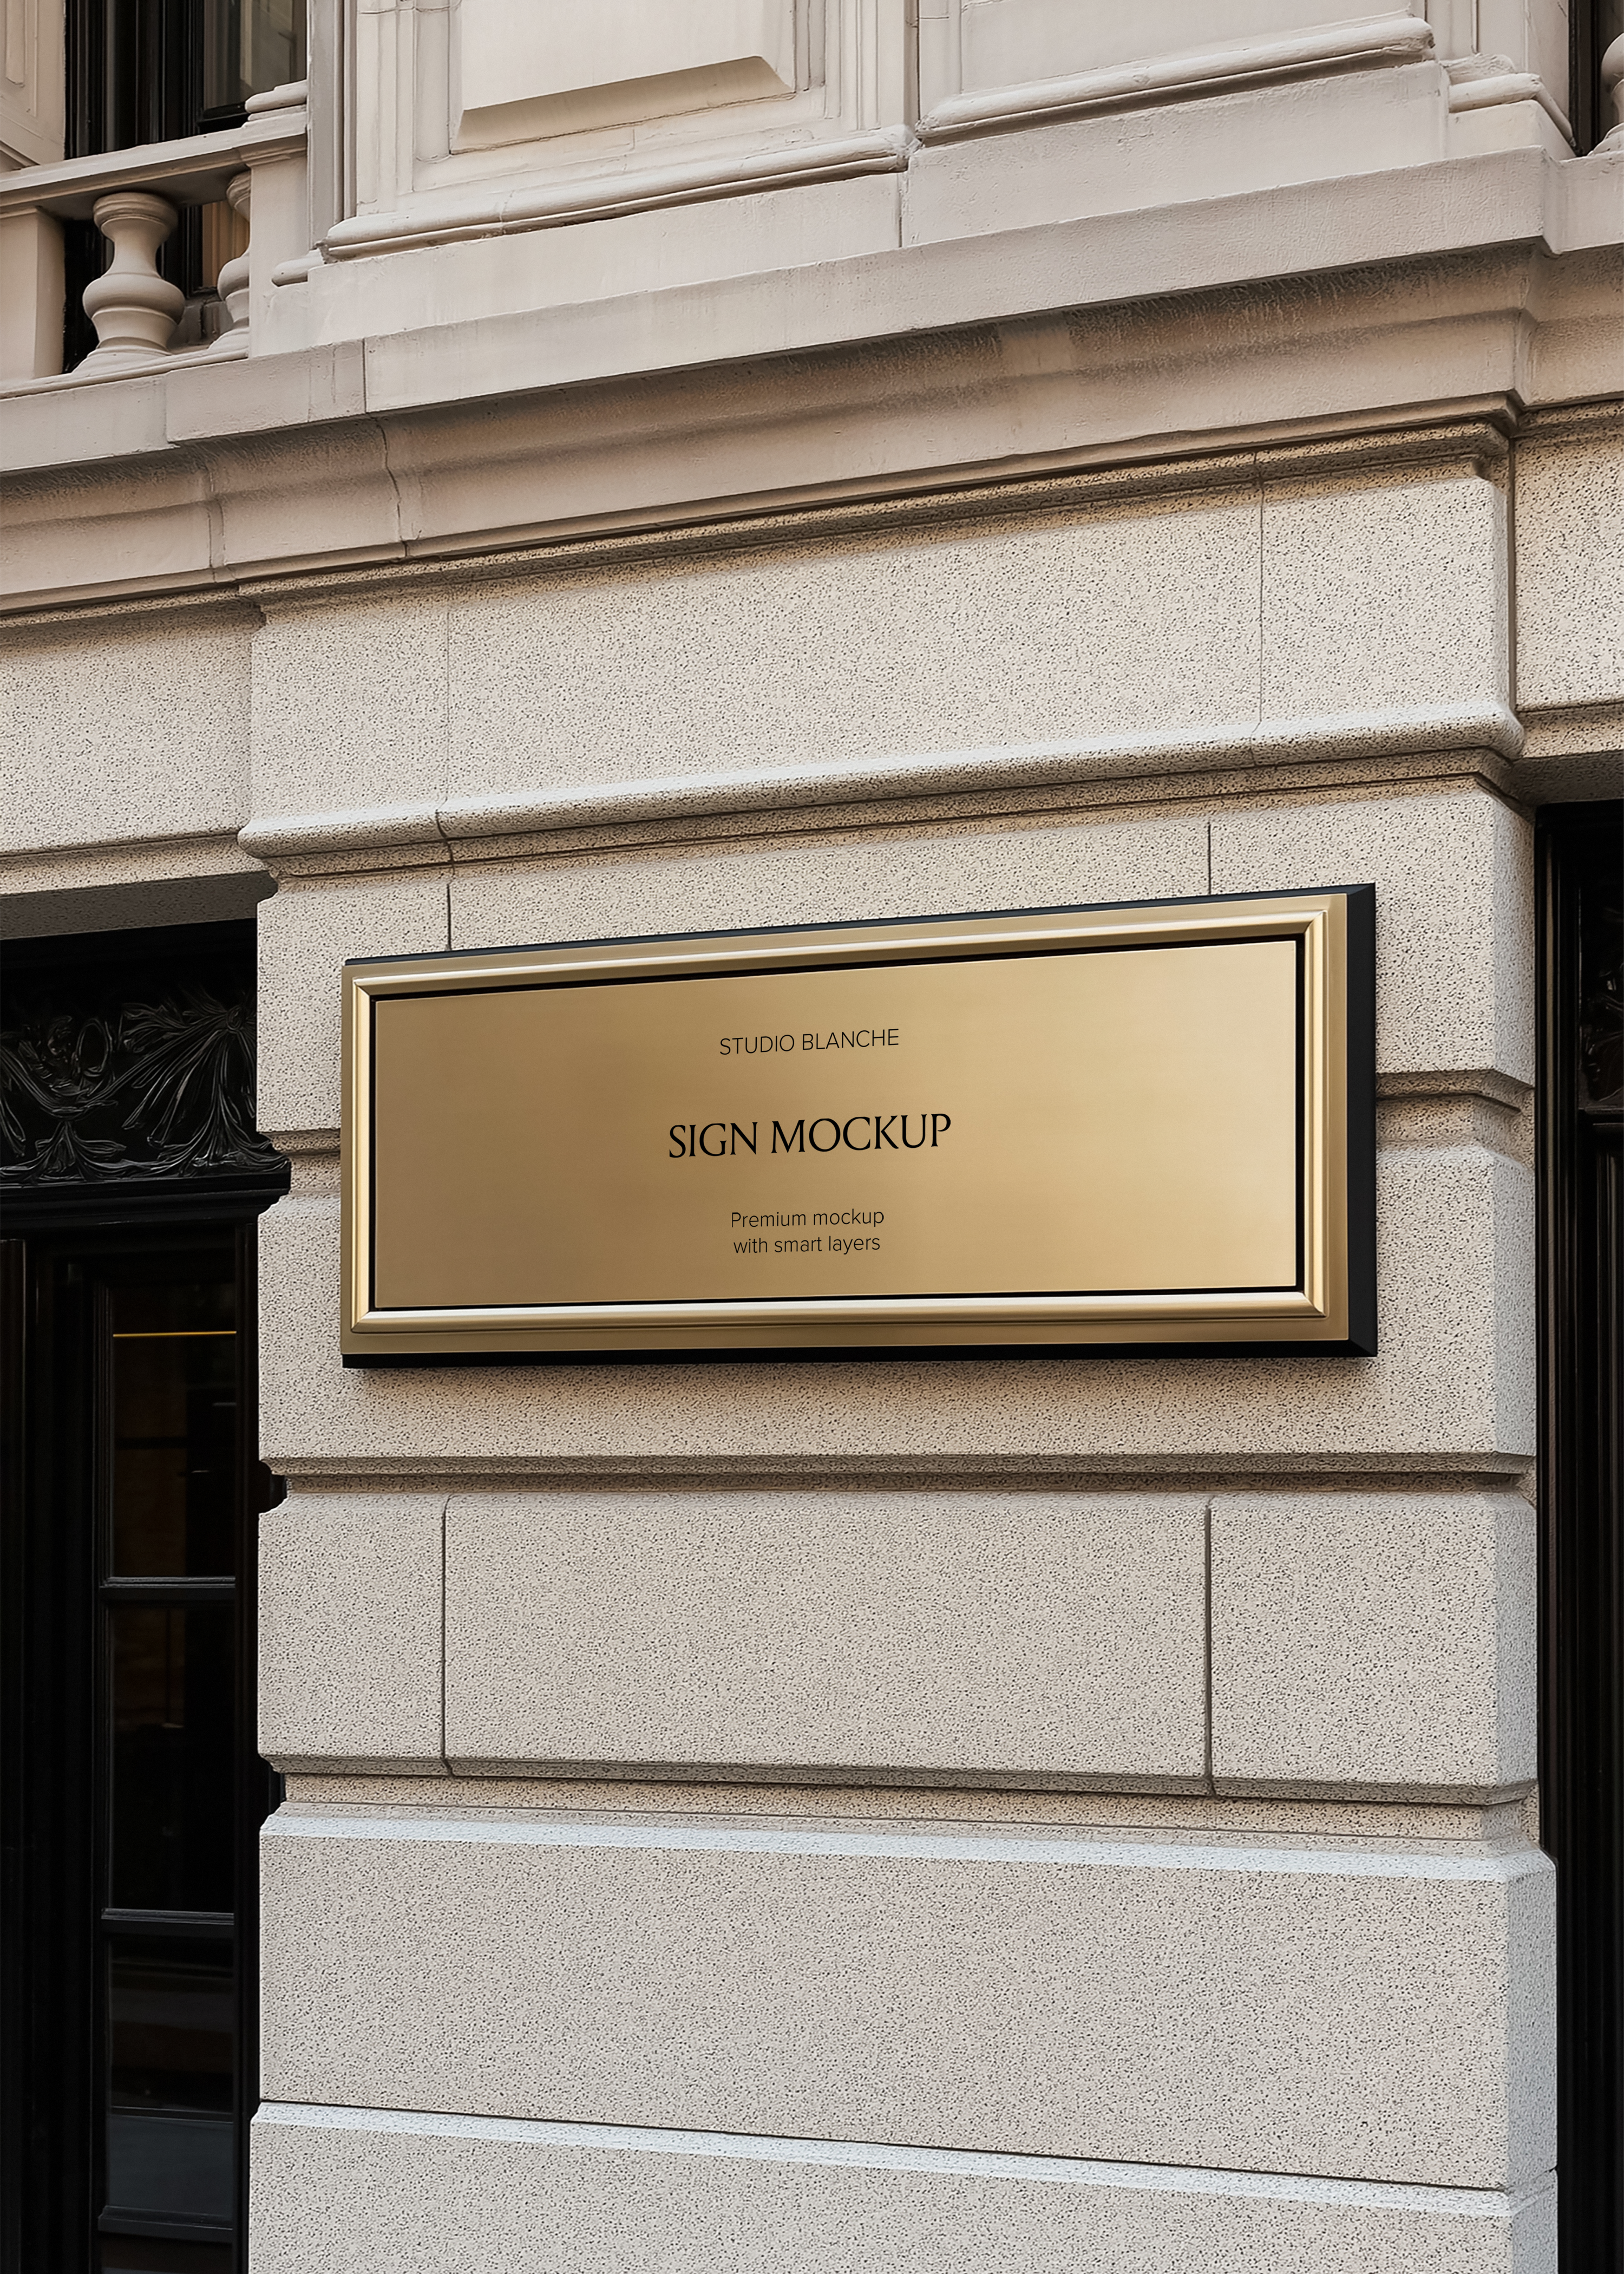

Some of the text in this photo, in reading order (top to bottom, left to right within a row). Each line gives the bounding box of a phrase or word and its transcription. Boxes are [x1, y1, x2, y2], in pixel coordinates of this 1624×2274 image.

[719, 1028, 900, 1055] STUDIO BLANCHE
[669, 1113, 952, 1159] SIGN MOCKUP
[731, 1208, 885, 1228] Premium mockup
[733, 1235, 881, 1255] with smart layers
